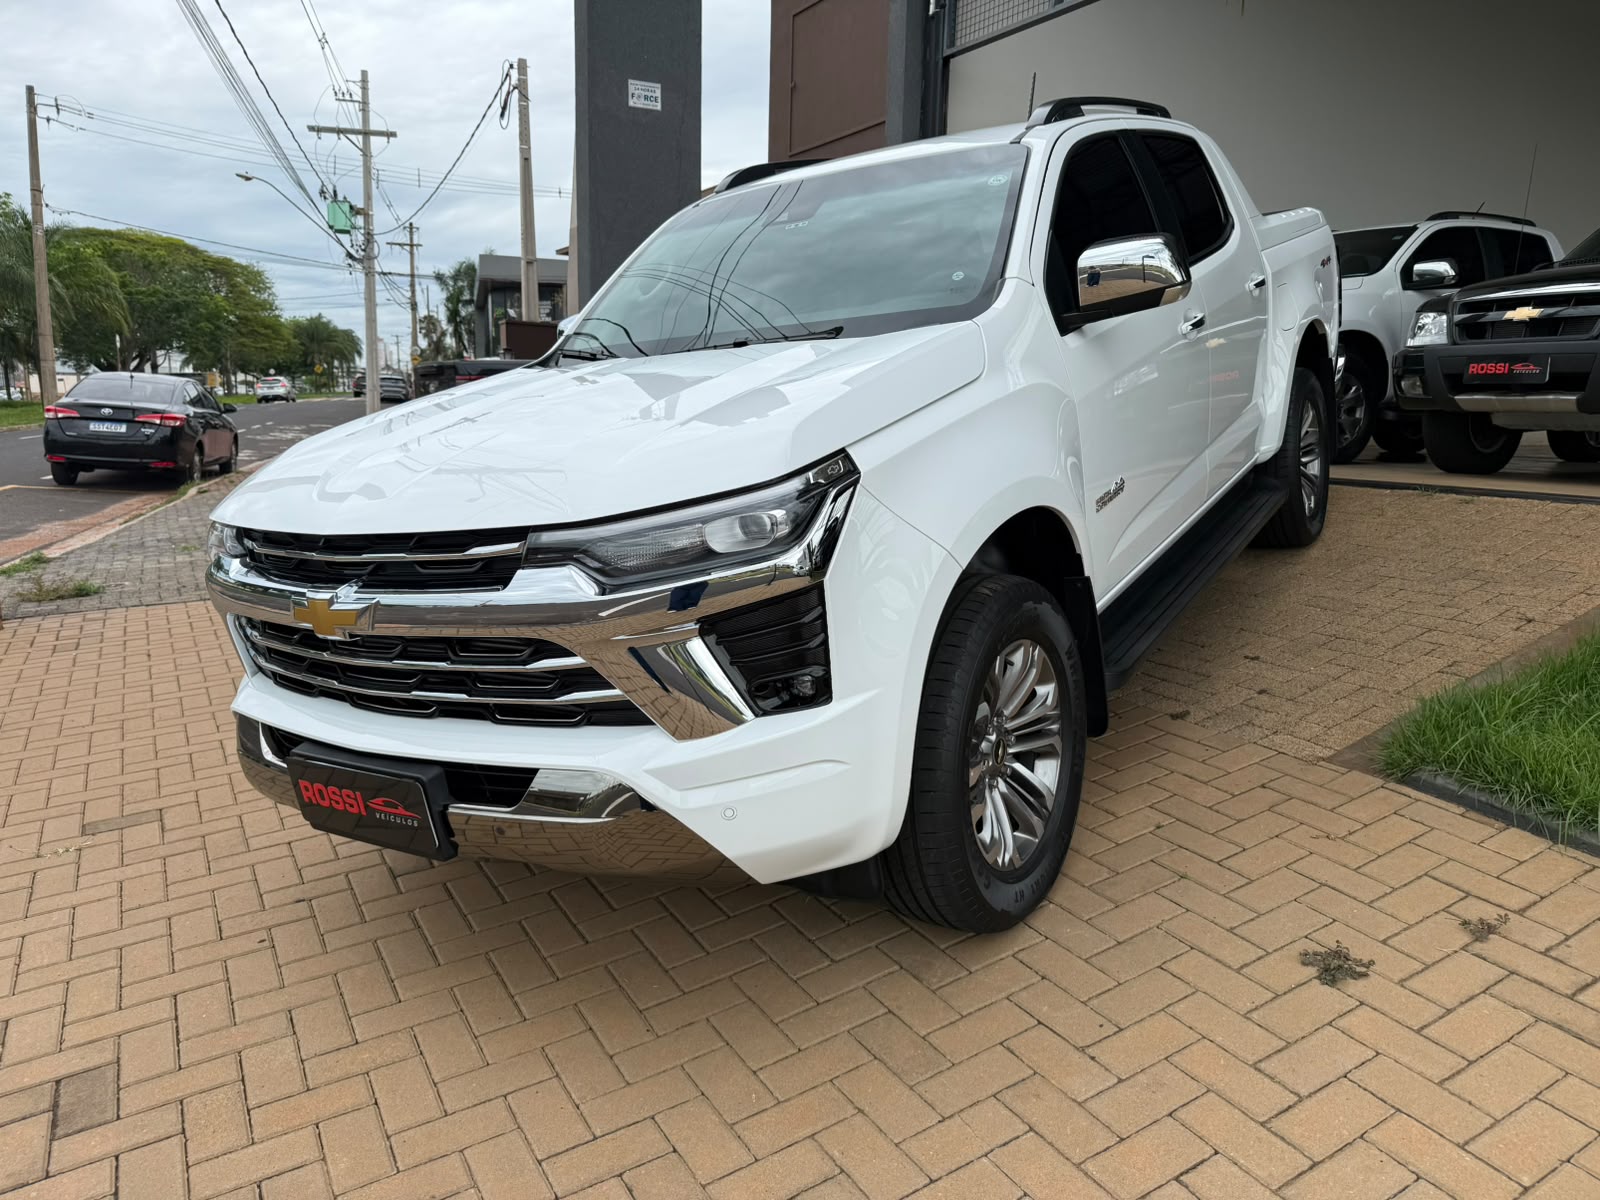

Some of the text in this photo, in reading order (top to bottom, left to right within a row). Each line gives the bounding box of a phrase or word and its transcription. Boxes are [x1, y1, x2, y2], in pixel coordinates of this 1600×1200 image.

[631, 92, 660, 104] FORCE
[1468, 363, 1510, 375] ROSSI
[298, 779, 367, 817] ROSSI
